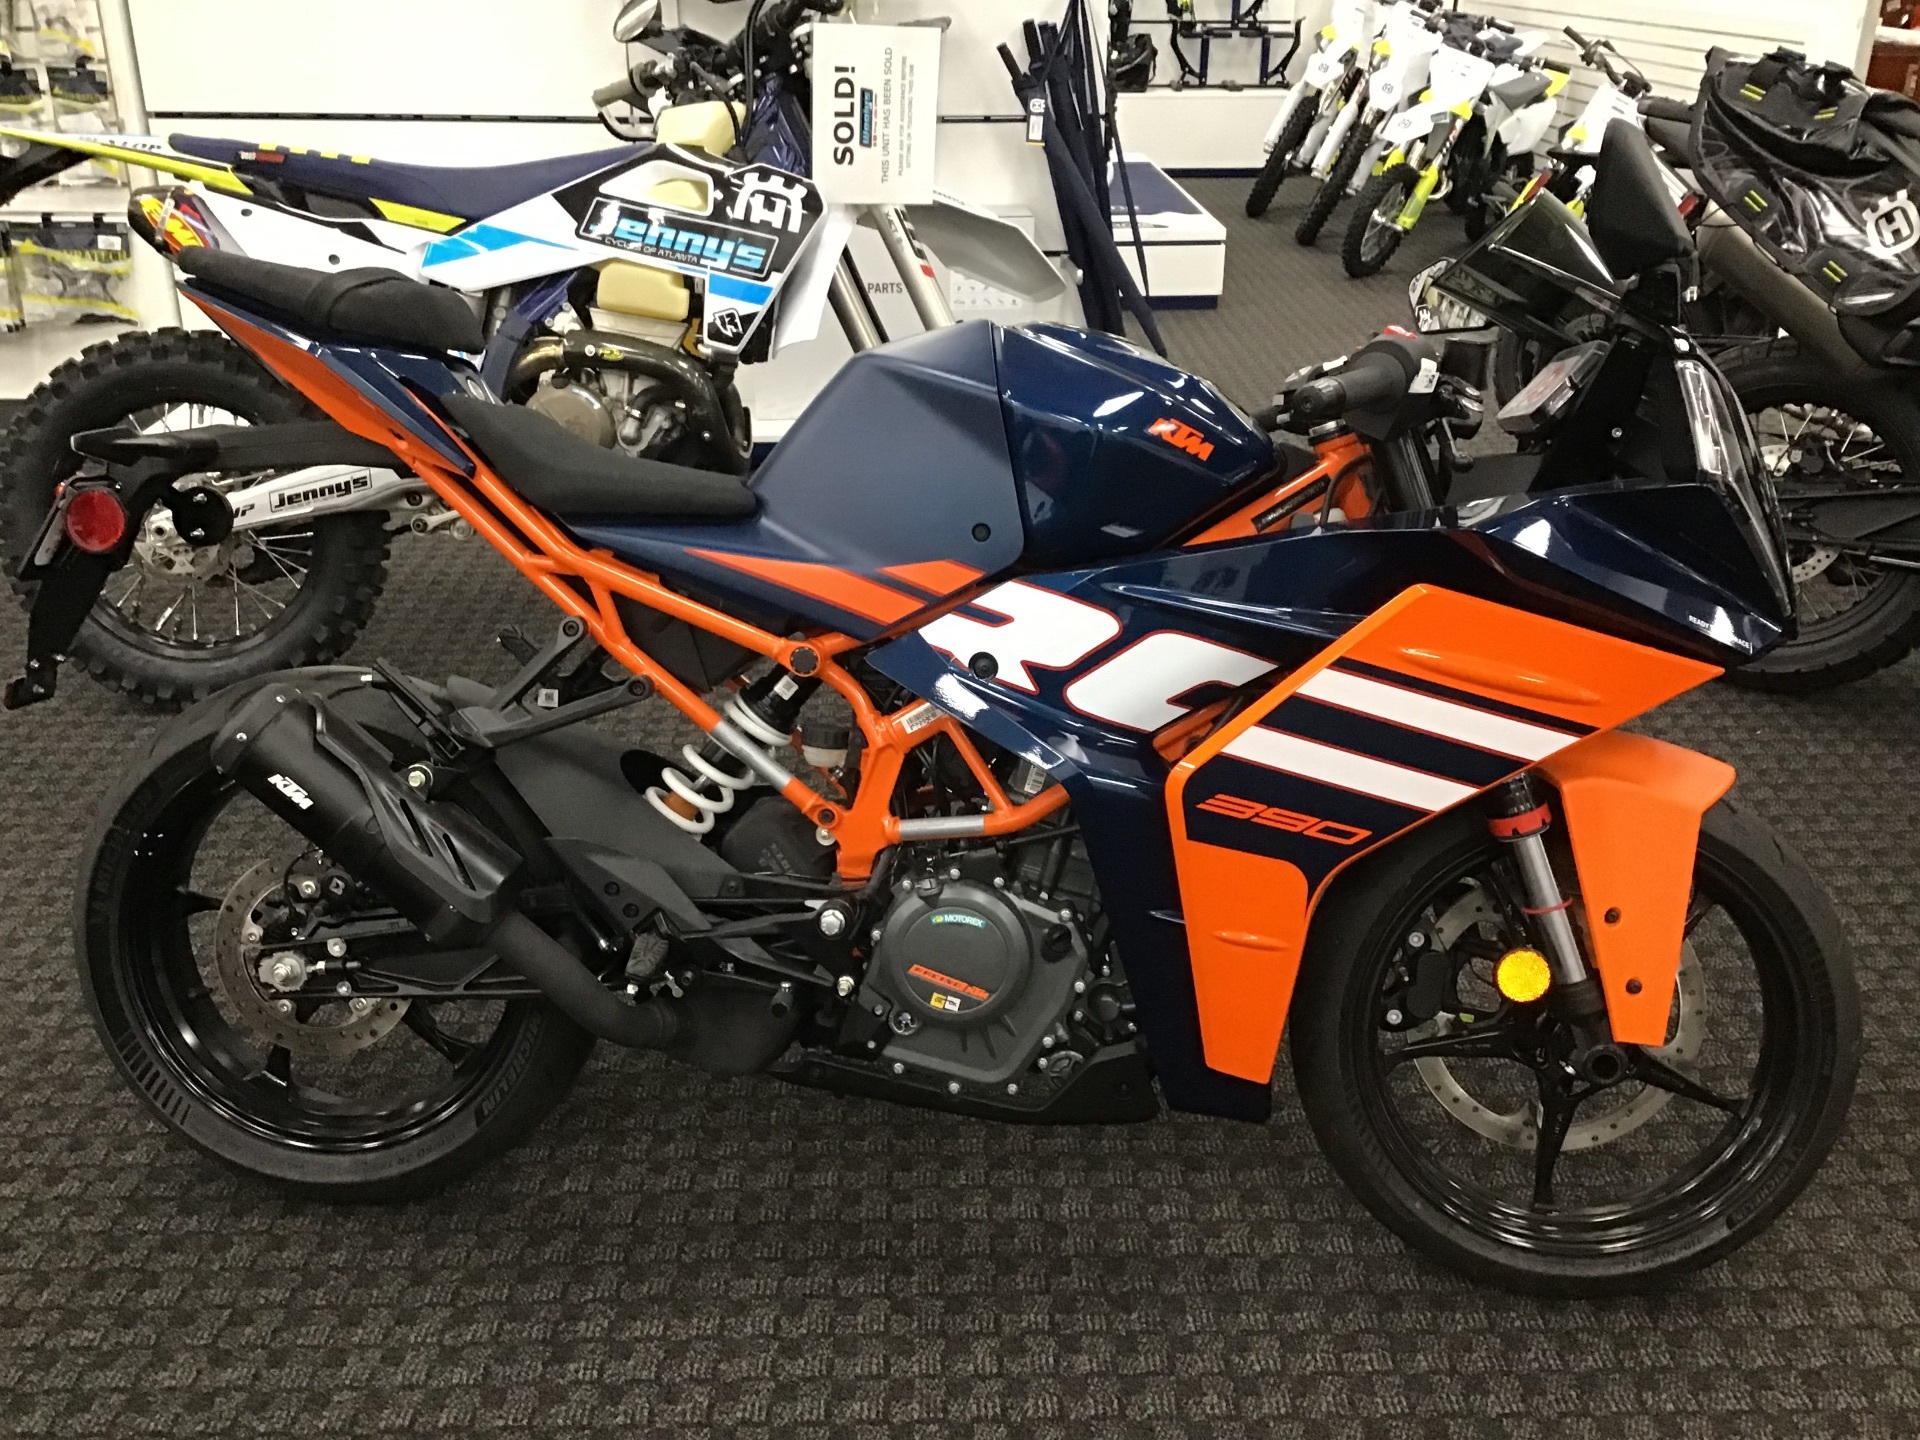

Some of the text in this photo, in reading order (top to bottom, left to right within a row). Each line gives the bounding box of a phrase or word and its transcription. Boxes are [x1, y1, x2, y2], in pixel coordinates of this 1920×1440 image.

[884, 47, 892, 76] SOLD
[834, 66, 855, 166] SOLD!
[883, 108, 891, 130] HAS
[882, 132, 890, 159] UNIT
[881, 161, 889, 184] THIS
[643, 244, 657, 254] OF
[658, 248, 698, 264] ATLANTA
[868, 282, 902, 294] PARTS
[1148, 417, 1215, 462] KTM
[274, 475, 368, 509] Jenny's
[1688, 614, 1710, 629] READY
[267, 773, 314, 810] KTM
[1195, 793, 1373, 846] 390
[944, 914, 983, 928] MOTOREX
